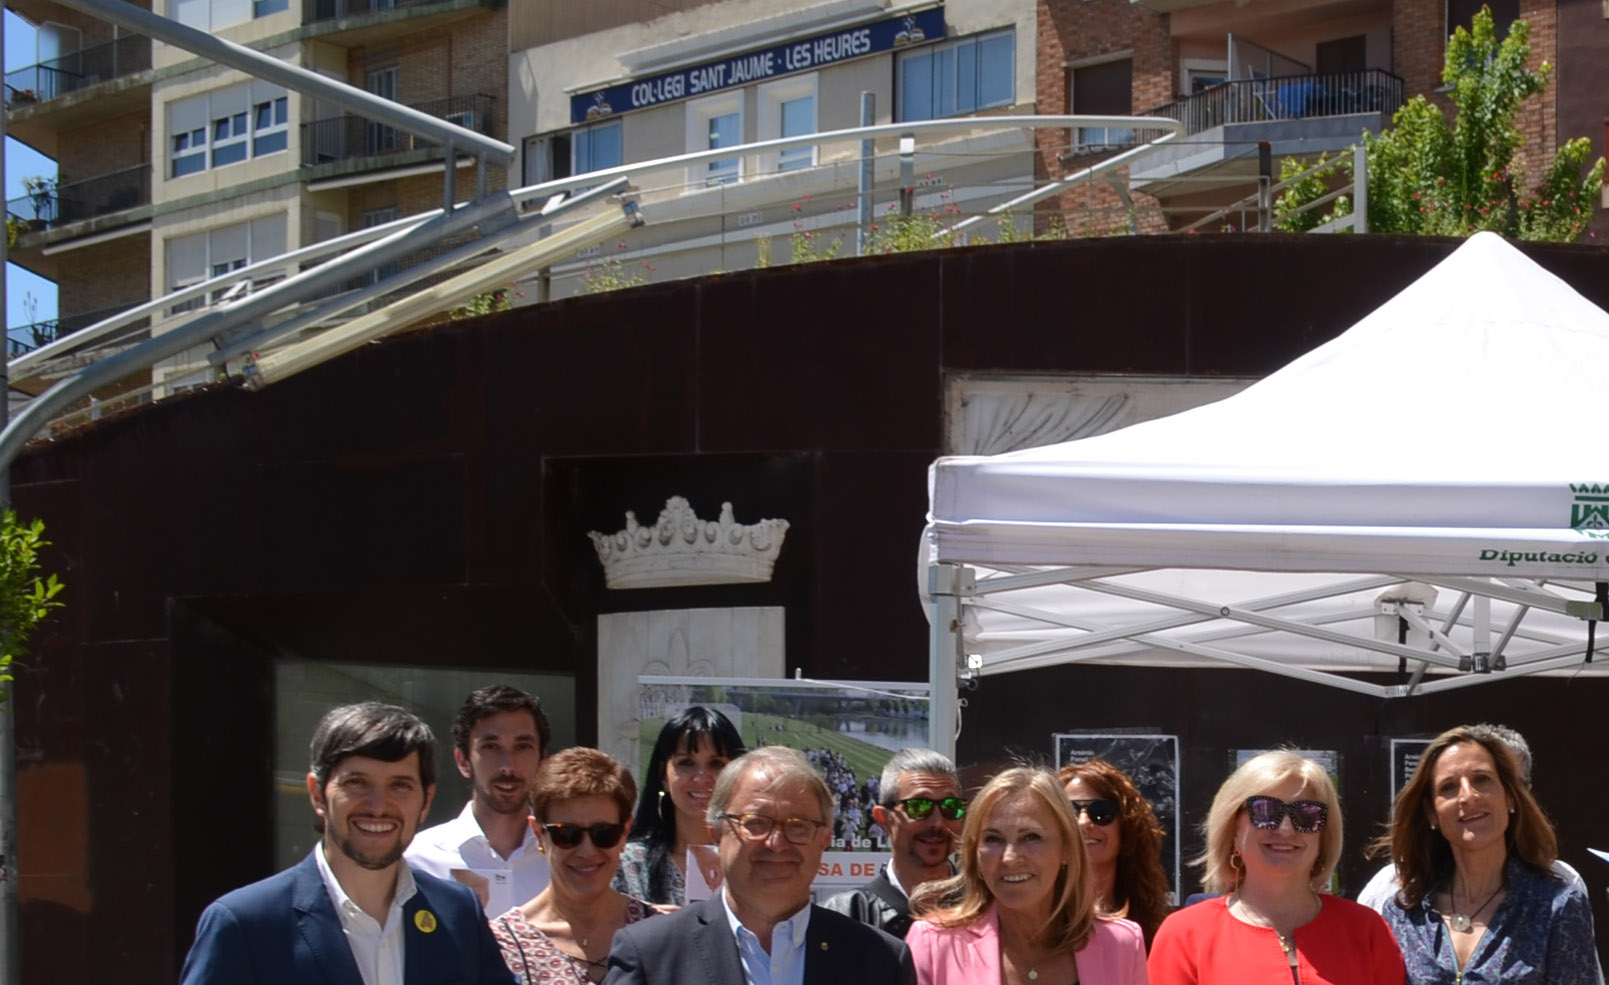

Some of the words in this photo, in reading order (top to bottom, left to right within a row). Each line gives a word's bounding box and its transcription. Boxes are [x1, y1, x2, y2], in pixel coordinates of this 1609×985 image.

[690, 64, 727, 93] SANT
[728, 52, 774, 85] JAUME
[785, 43, 811, 70] LES
[814, 29, 871, 63] HEURES
[1478, 548, 1599, 567] Diputació
[852, 834, 872, 848] de
[818, 863, 843, 876] SA
[850, 863, 875, 876] DE
